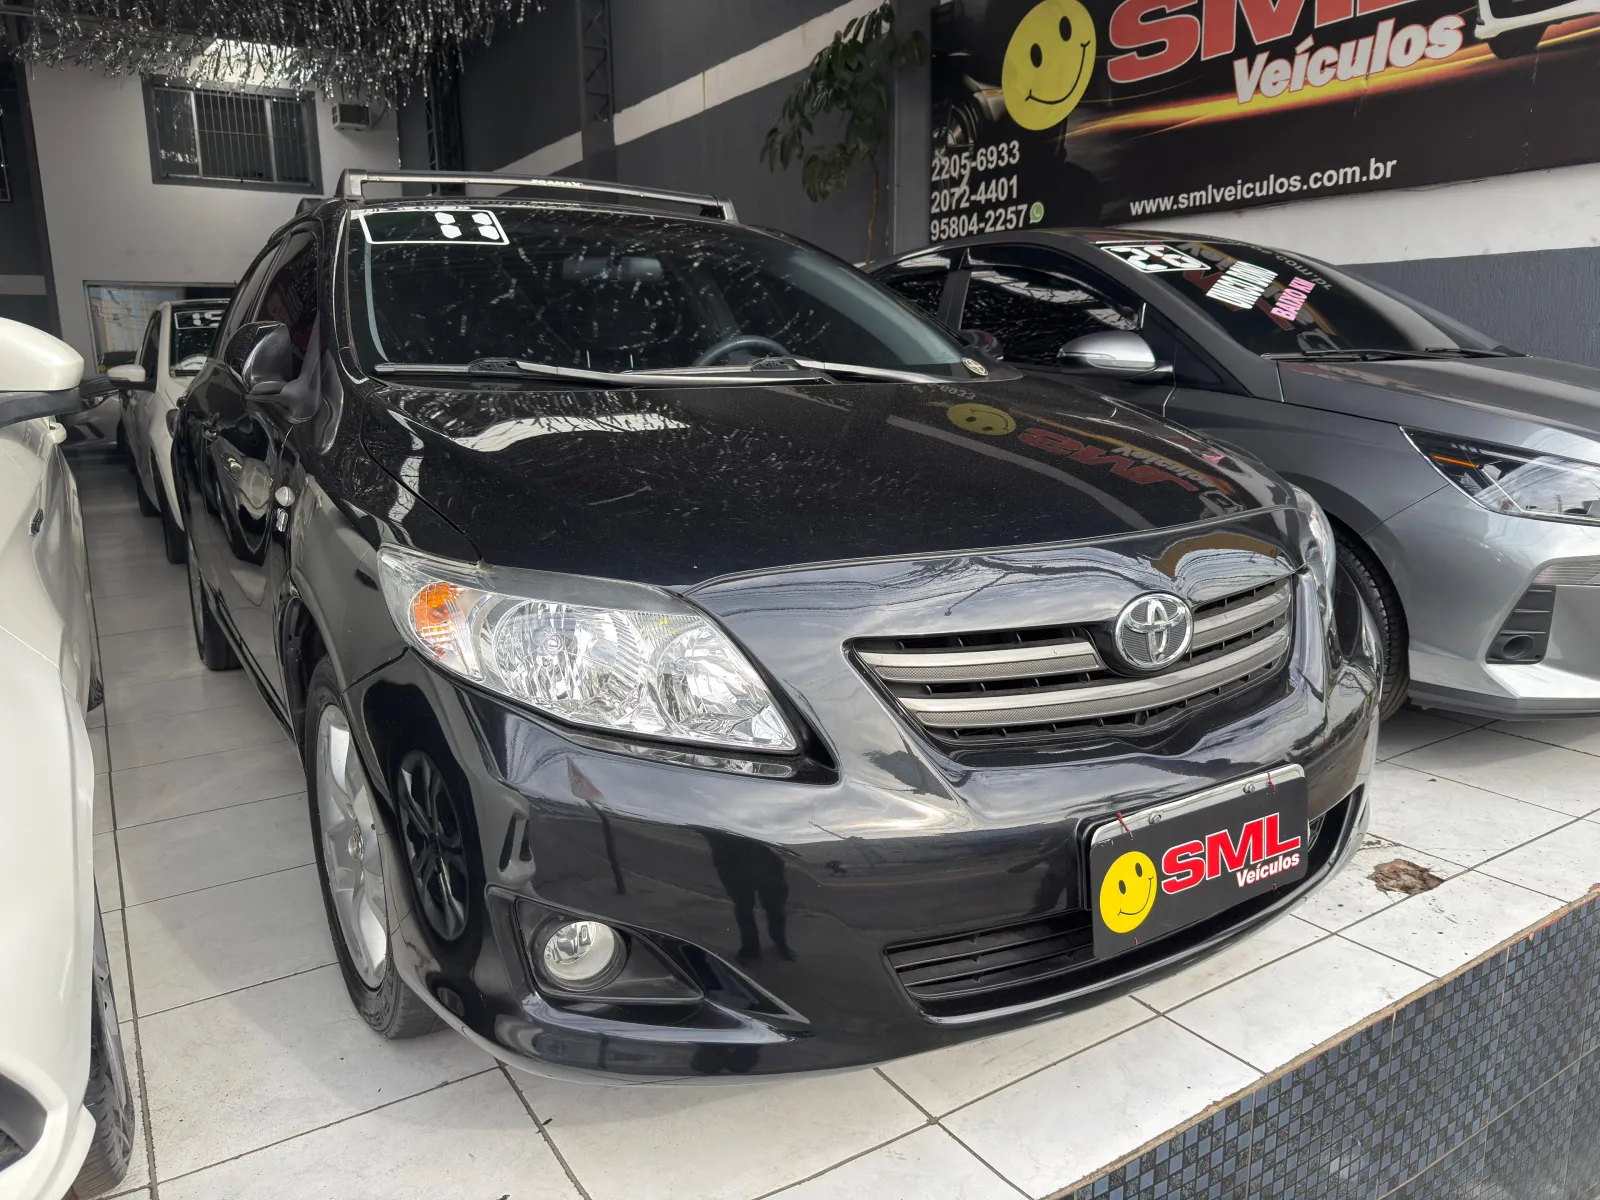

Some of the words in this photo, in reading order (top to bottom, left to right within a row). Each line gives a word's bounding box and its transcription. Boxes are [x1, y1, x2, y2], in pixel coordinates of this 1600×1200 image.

[1107, 0, 1415, 83] SM
[1233, 15, 1466, 104] Veículos
[931, 140, 1020, 182] 2205-6933
[931, 174, 1018, 214] 2072-4401
[1129, 157, 1397, 216] www.smlveiculos.com.br
[930, 203, 1029, 241] 95804-2257
[1270, 287, 1308, 322] BAIXO
[1288, 276, 1316, 294] KM
[1161, 811, 1301, 895] SML
[1236, 852, 1300, 889] Veículos
